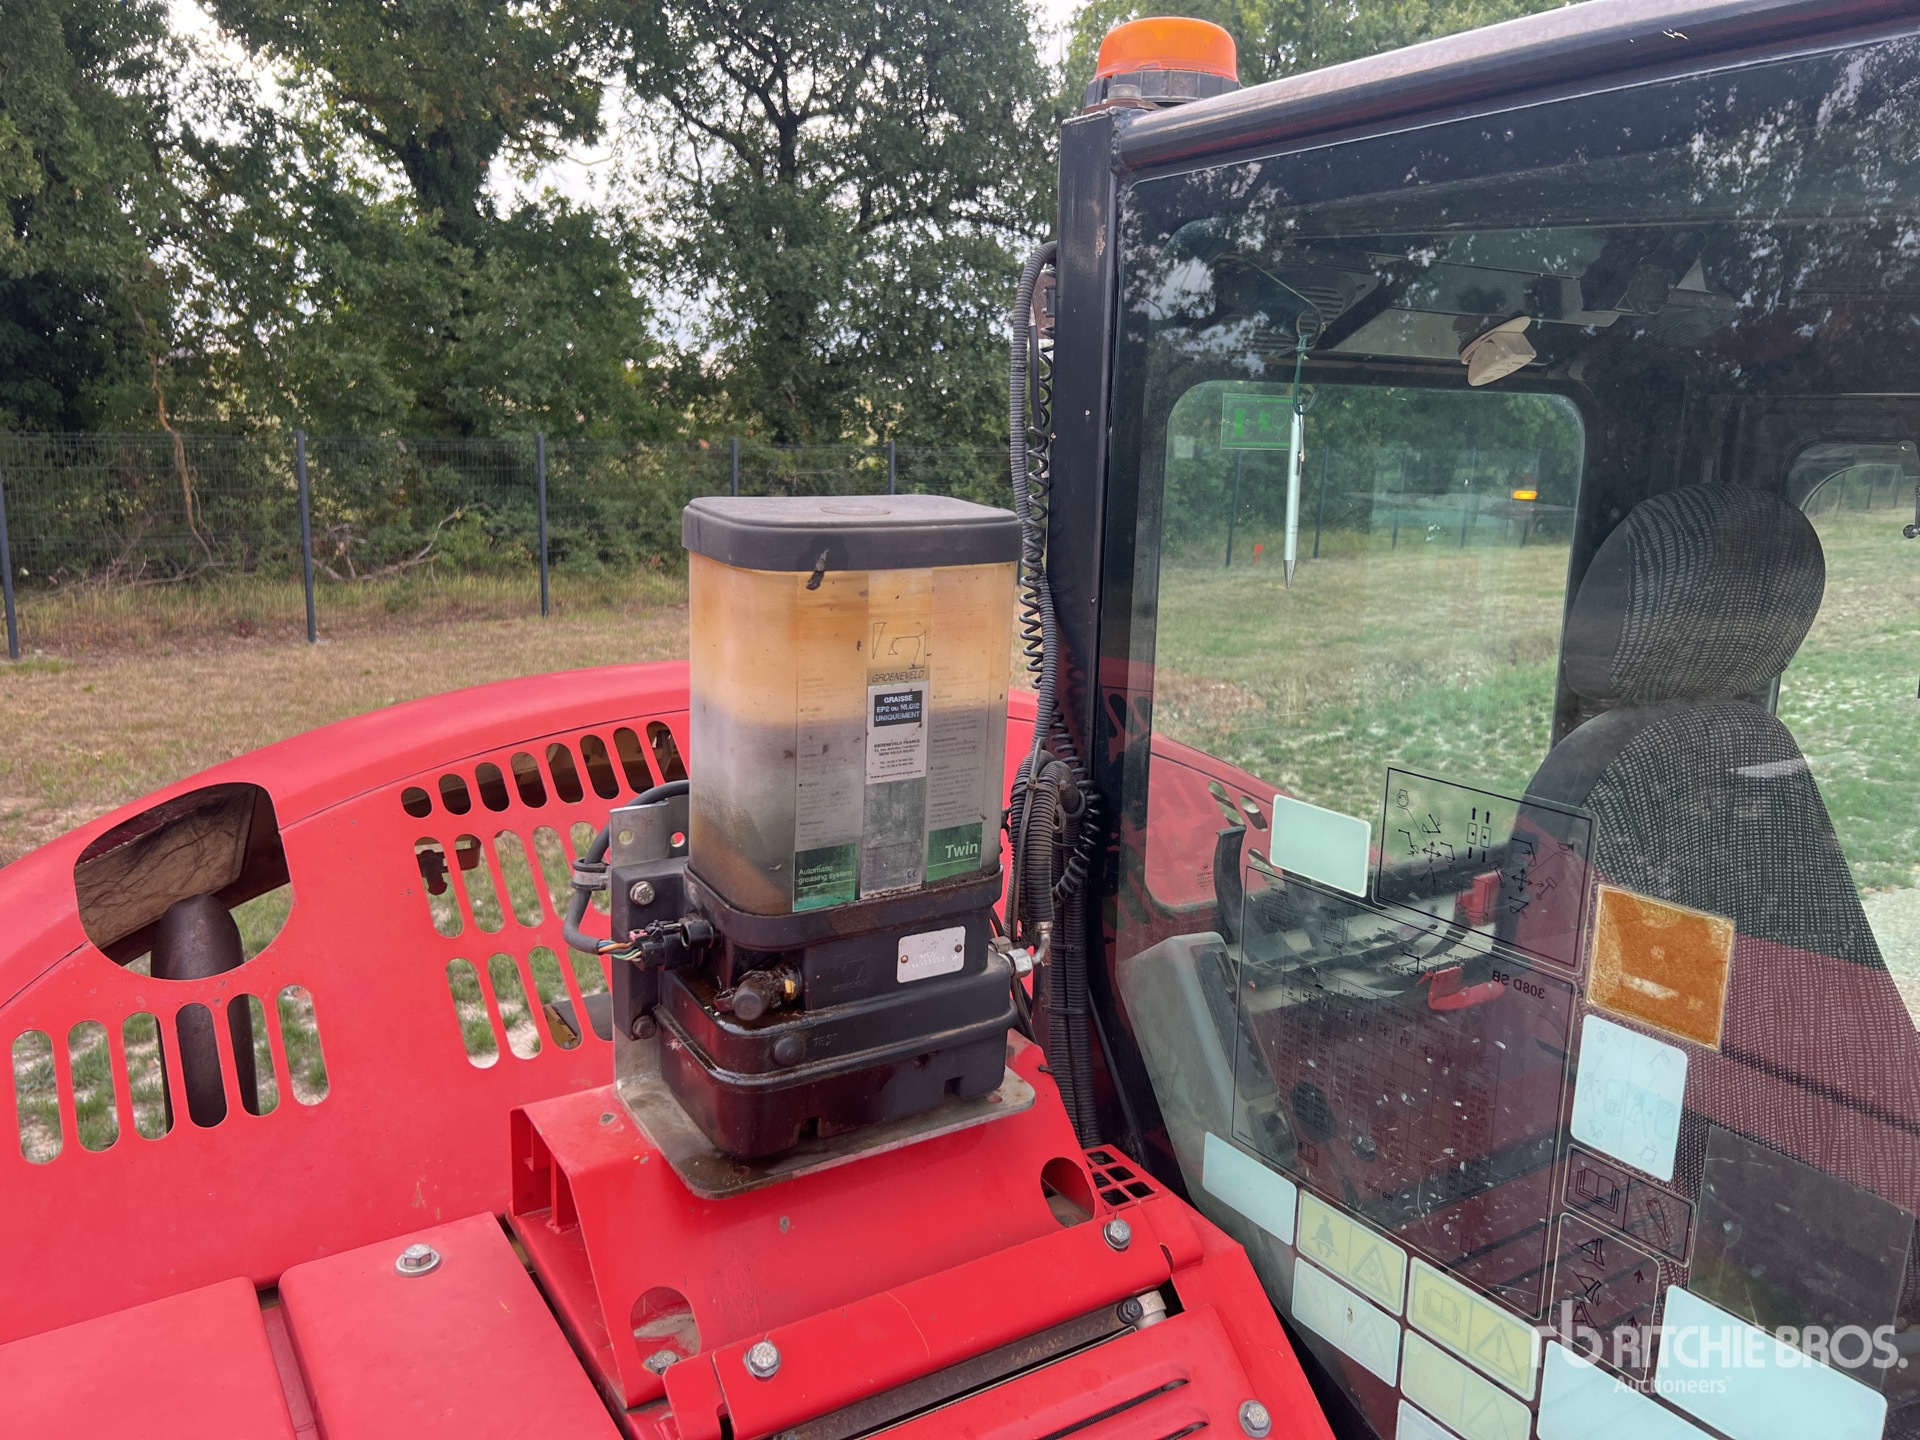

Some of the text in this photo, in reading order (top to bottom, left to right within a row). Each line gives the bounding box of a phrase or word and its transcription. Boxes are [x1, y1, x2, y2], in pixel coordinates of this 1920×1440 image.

[872, 669, 925, 683] GROENEVELD
[883, 694, 914, 705] GRAISSE
[876, 702, 921, 714] EP2 ou NLGI2
[875, 710, 921, 723] UNIQUEMENT
[944, 842, 978, 859] Twin
[798, 864, 833, 876] Automatic
[797, 870, 853, 886] greasing system
